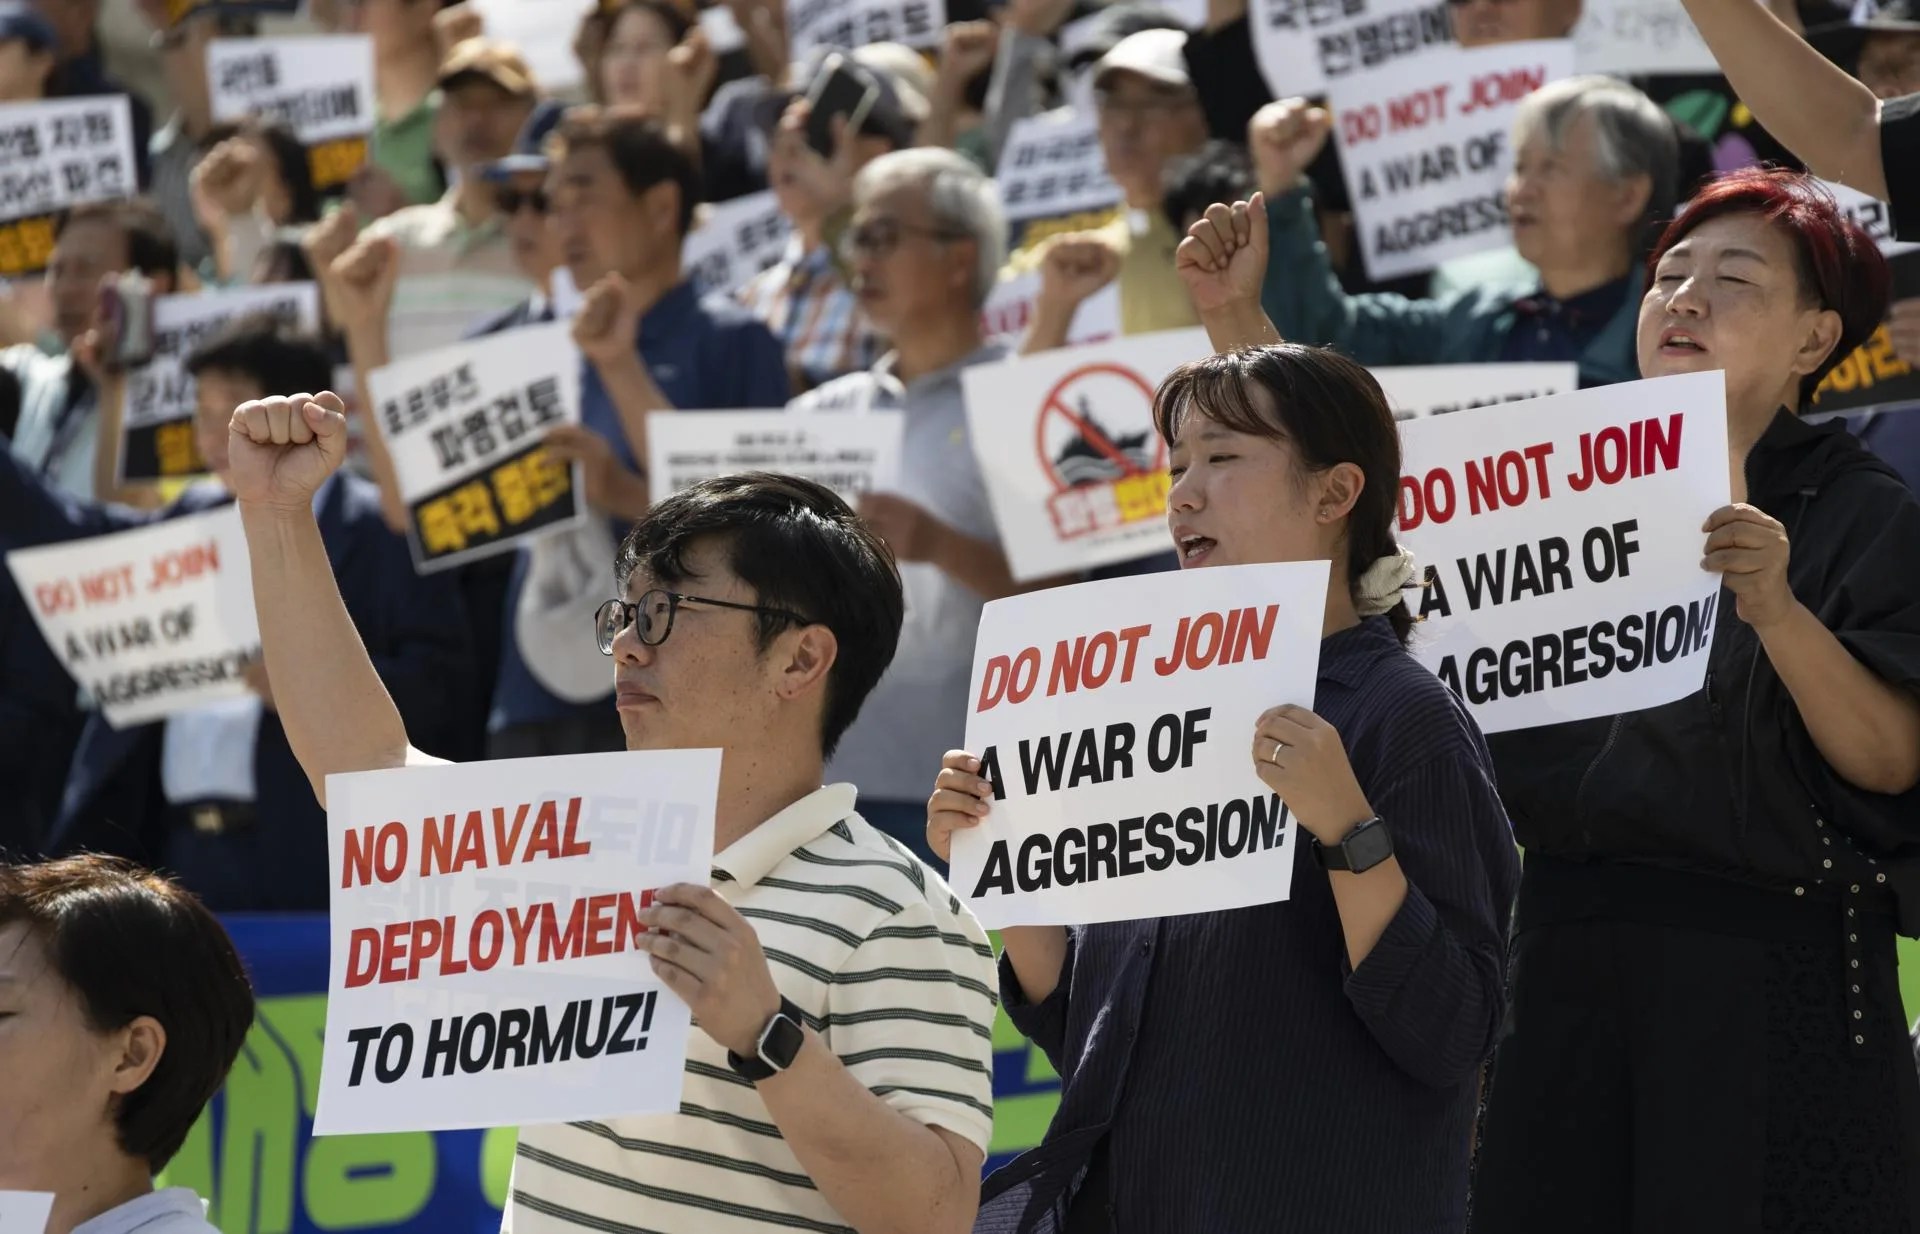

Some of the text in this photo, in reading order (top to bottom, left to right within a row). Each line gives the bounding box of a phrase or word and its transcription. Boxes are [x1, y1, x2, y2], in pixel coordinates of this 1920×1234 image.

[1342, 64, 1547, 146] DO NOT JOIN
[1360, 130, 1505, 199] A WAR OF
[1399, 412, 1684, 532] DO NOT JOIN
[35, 539, 220, 619] DO NOT JOIN
[1419, 518, 1640, 619] A WAR OF
[64, 603, 195, 662] A WAR OF
[976, 604, 1280, 713] DO NOT JOIN
[1436, 590, 1718, 705] AGGRESSION!
[978, 706, 1212, 801] A WAR OF
[341, 821, 408, 888] NO
[419, 797, 592, 878] NAVAL
[971, 792, 1289, 899] AGGRESSION!
[344, 887, 663, 989] DEPLOYMEN
[347, 990, 658, 1087] TO HORMUZ!
